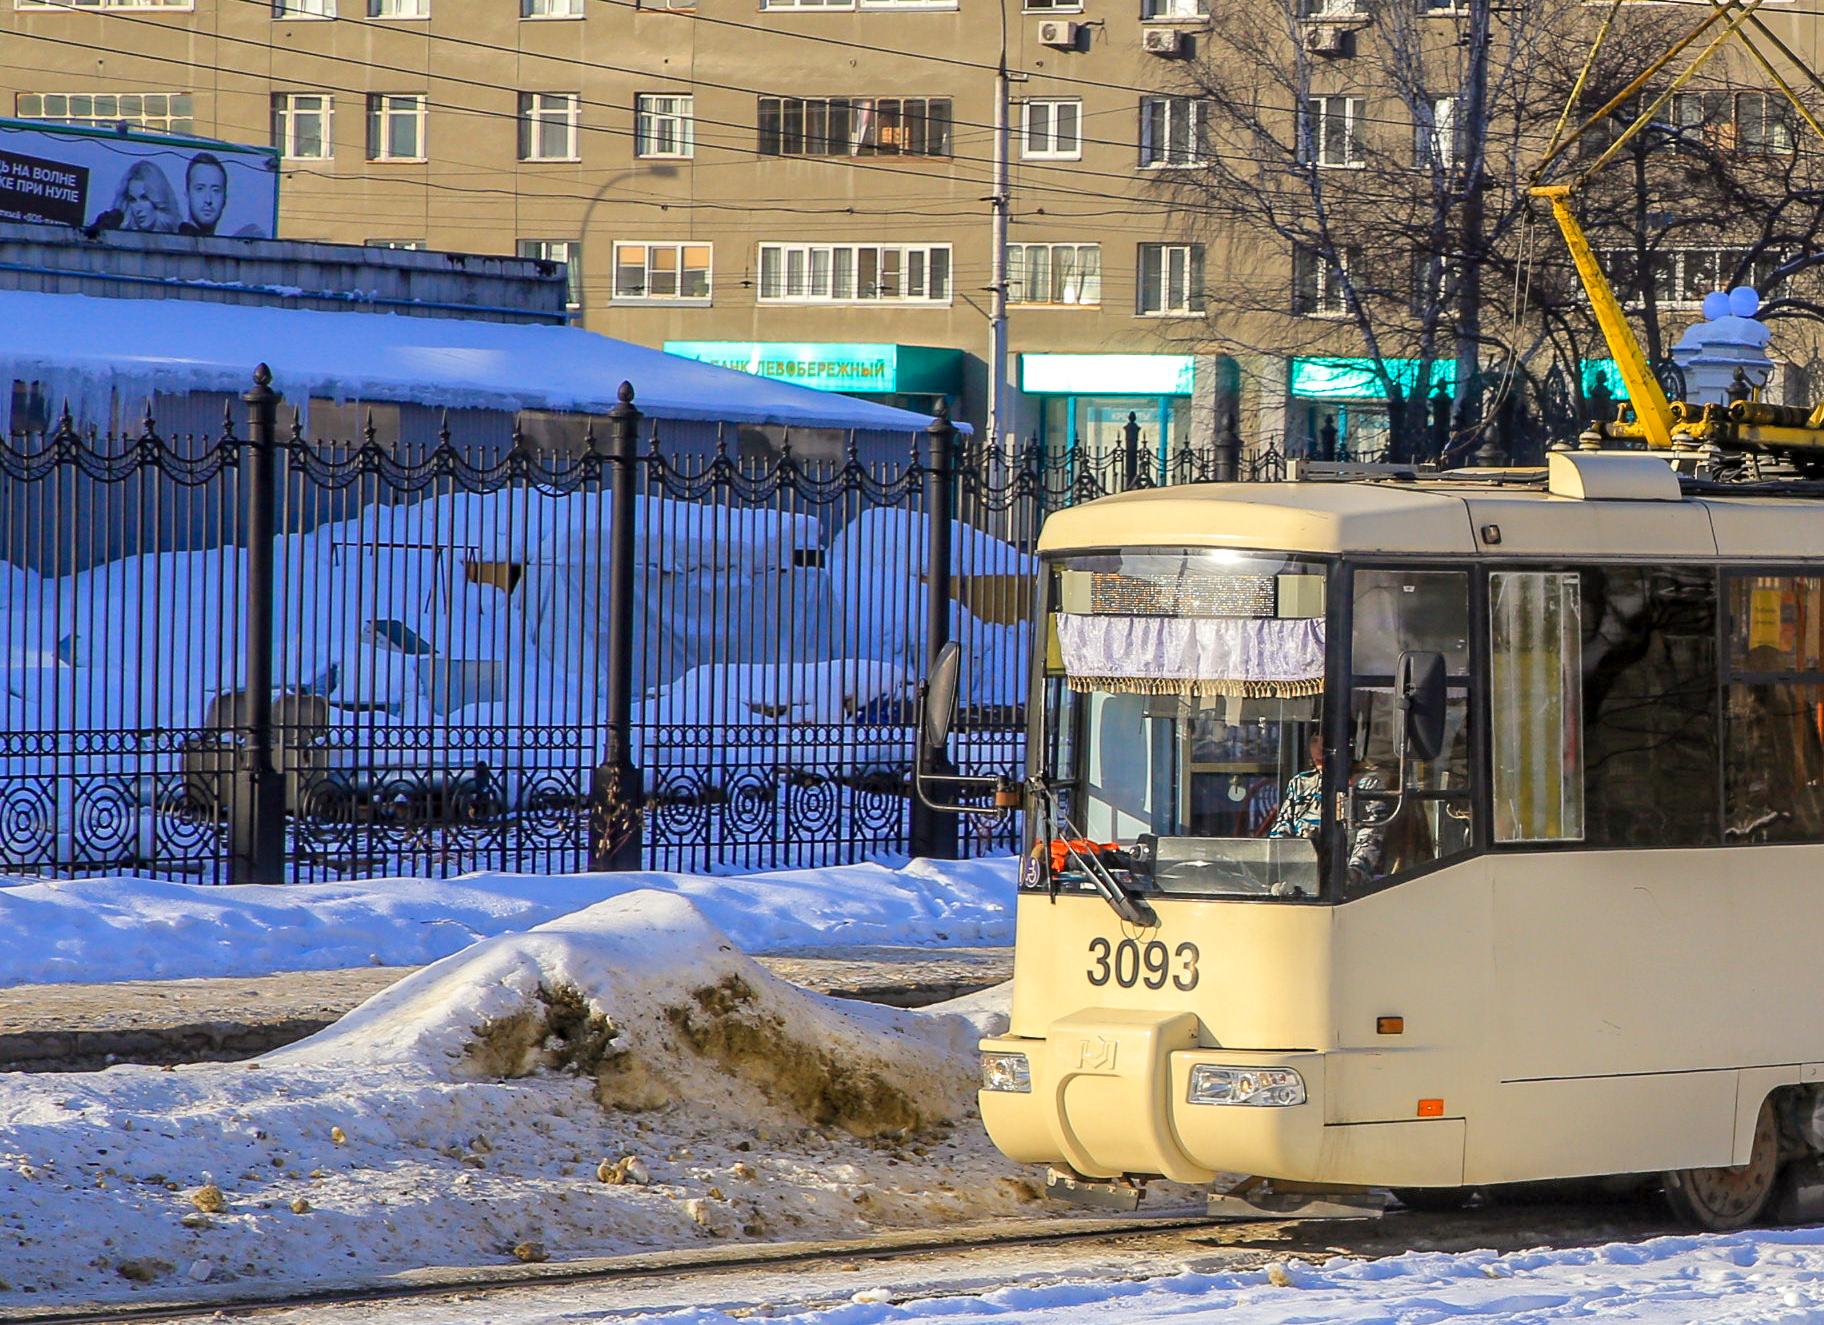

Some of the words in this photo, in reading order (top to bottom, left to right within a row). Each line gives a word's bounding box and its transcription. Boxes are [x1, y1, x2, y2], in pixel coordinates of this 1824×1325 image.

[0, 160, 10, 173] Ь
[12, 163, 30, 177] НА
[33, 167, 77, 187] ВОЛНЕ
[16, 179, 43, 195] ПРИ
[45, 185, 80, 203] НУЛЕ
[755, 359, 885, 378] ЛЕВОБЕРЕЖНЫЙ
[1086, 937, 1200, 991] 3093
